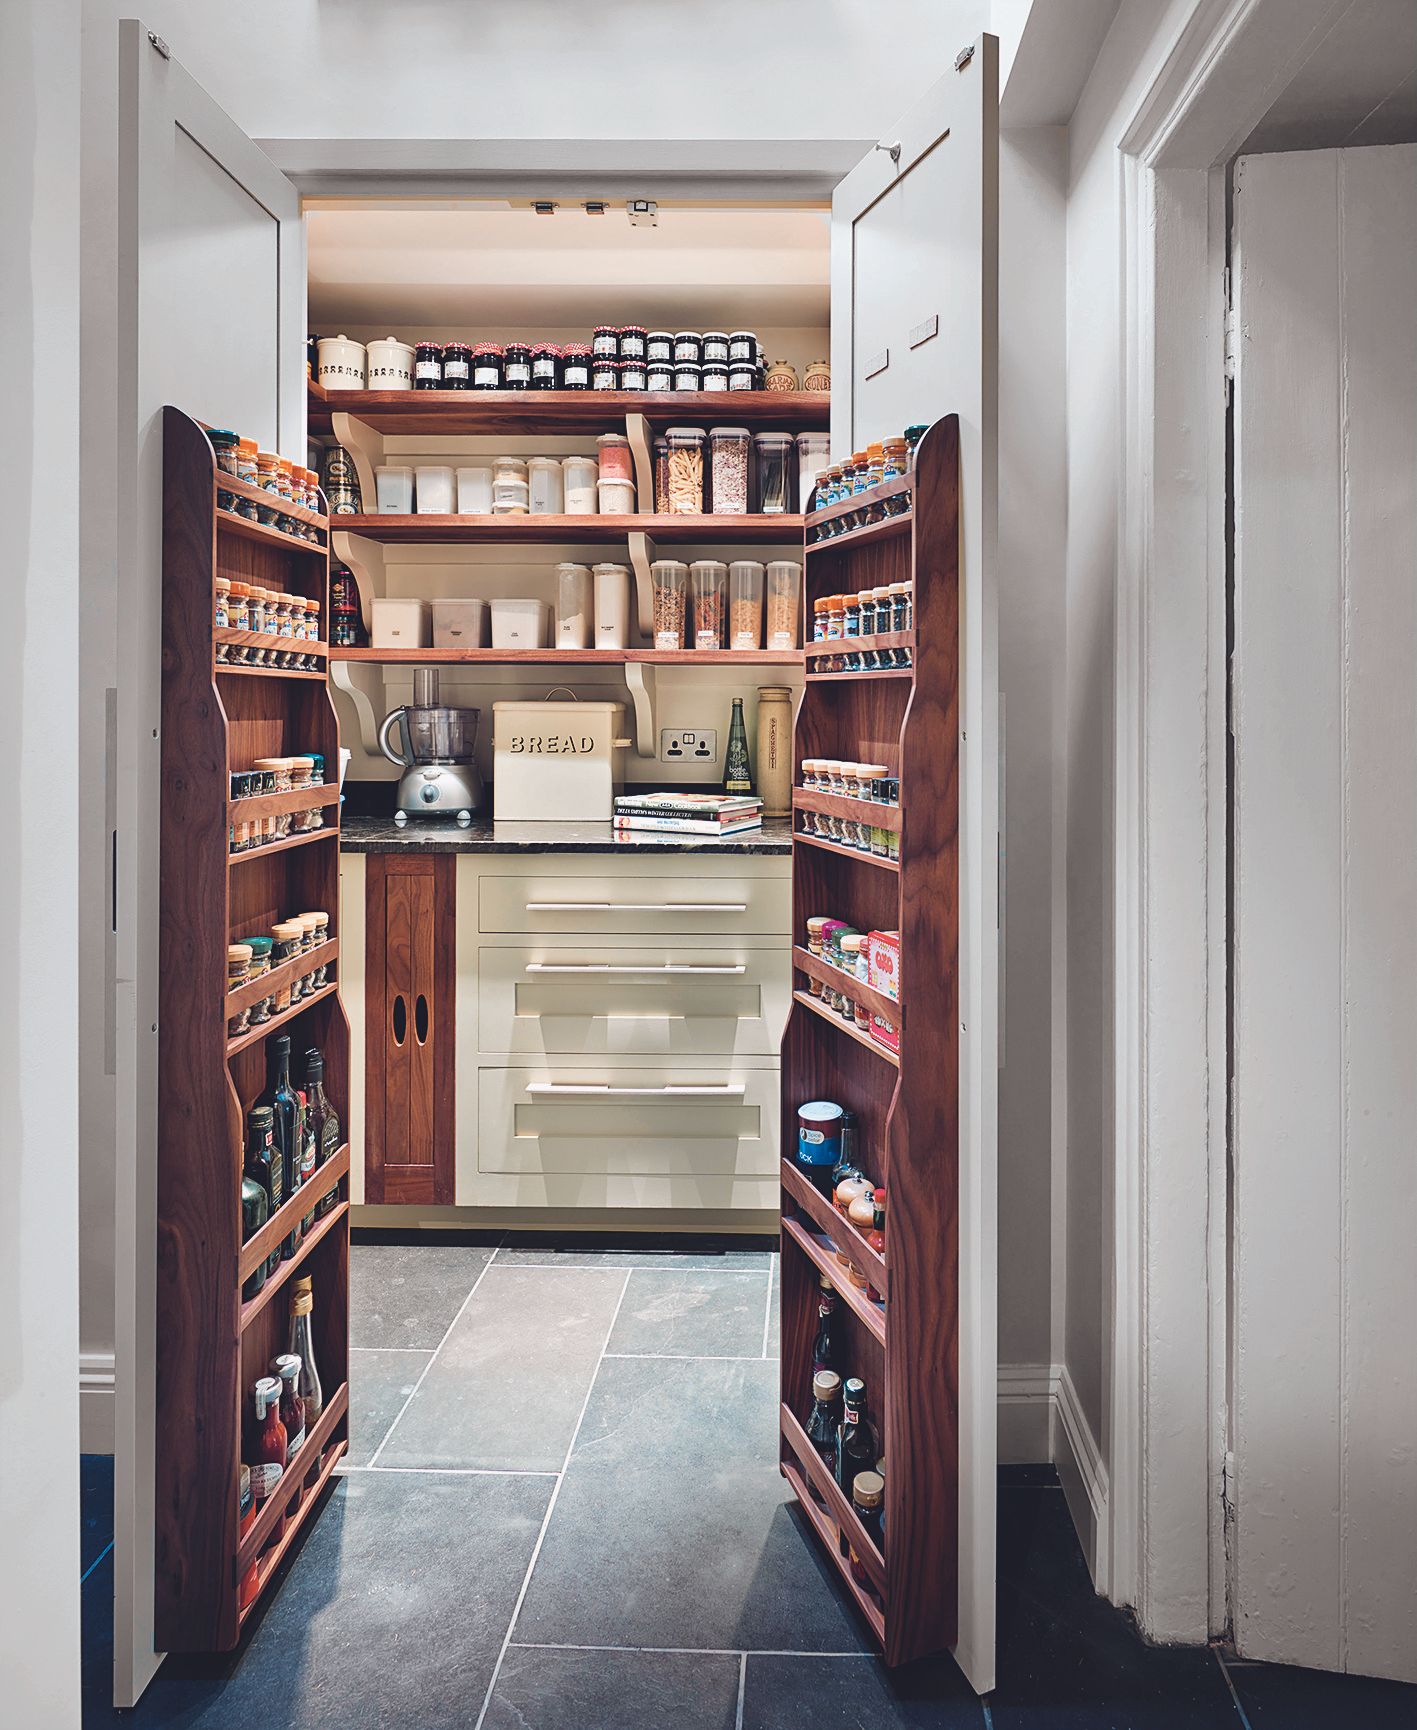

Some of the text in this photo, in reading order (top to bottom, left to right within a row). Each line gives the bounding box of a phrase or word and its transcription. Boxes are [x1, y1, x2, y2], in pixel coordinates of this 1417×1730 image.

[807, 376, 830, 391] HONE
[510, 735, 595, 753] BREAD
[769, 717, 777, 769] SPAGHETTI
